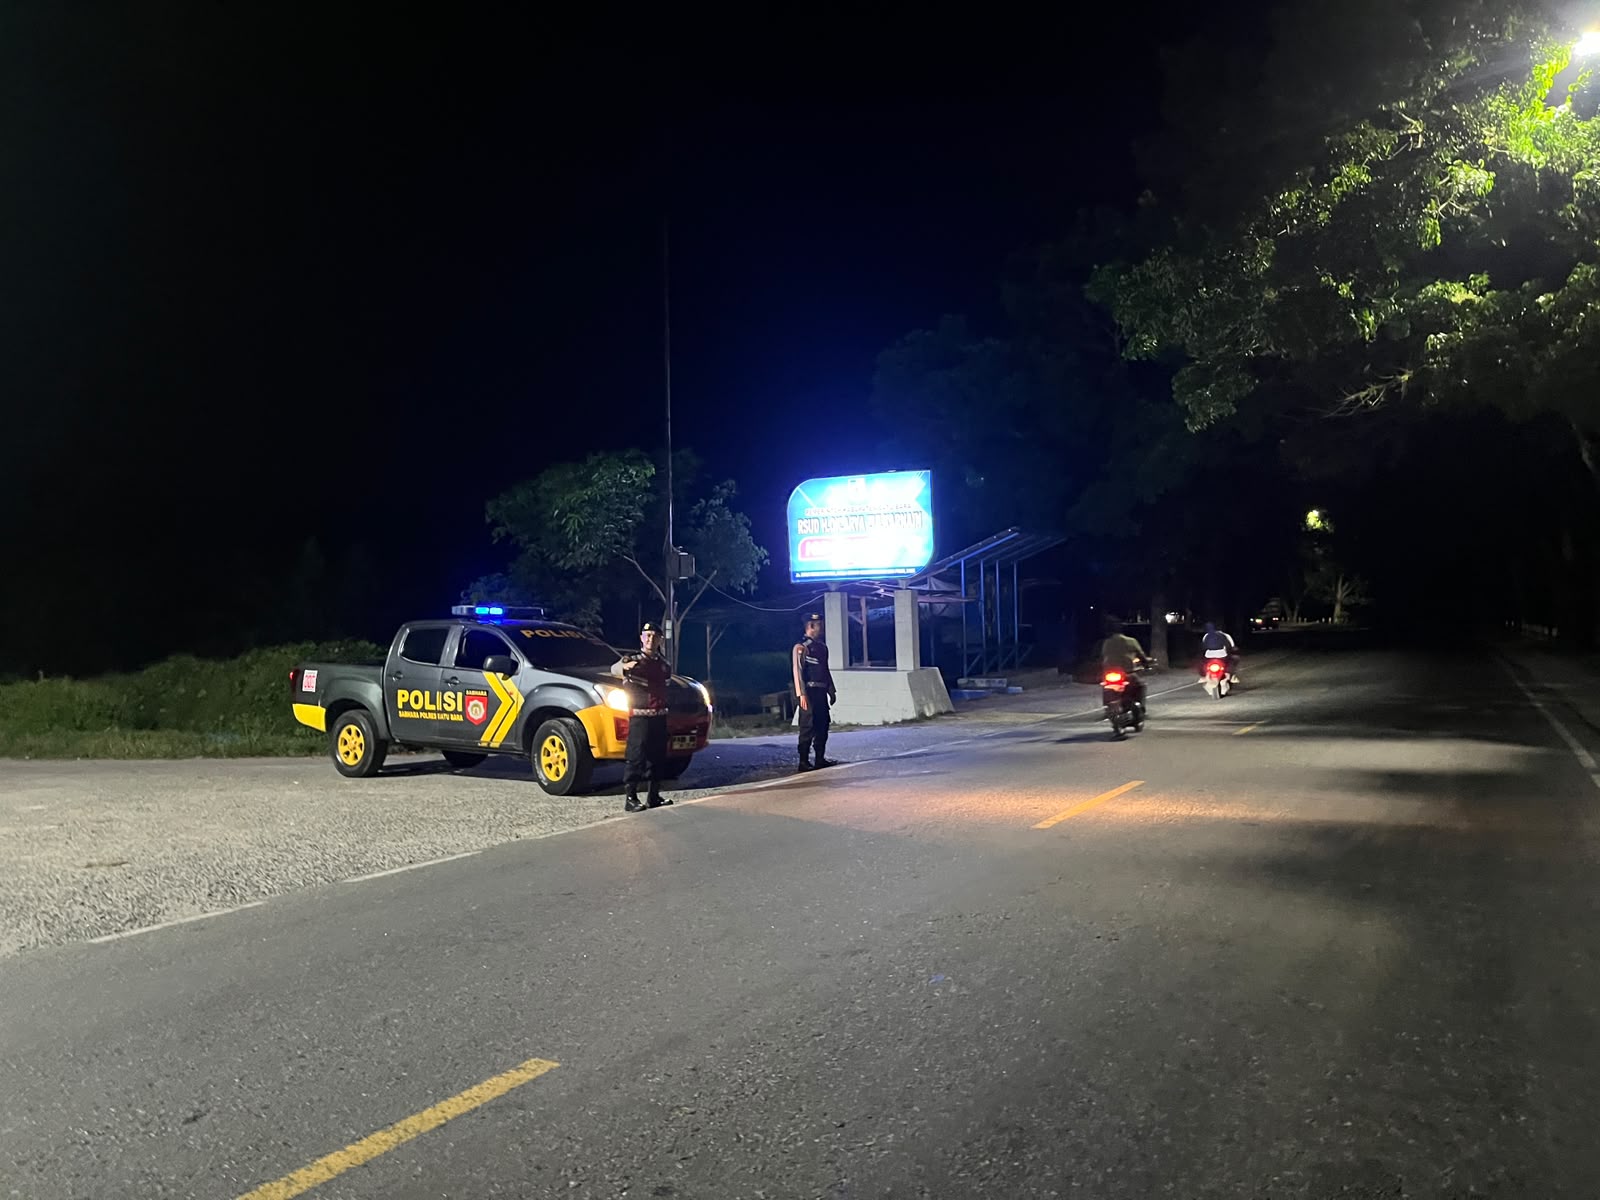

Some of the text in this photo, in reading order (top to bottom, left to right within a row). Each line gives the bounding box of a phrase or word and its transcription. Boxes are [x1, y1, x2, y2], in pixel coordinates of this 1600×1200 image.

[798, 518, 821, 534] RSUD
[520, 629, 587, 639] POLISI
[397, 690, 463, 711] POLISI
[419, 711, 437, 720] POLRES
[450, 713, 464, 722] BARA
